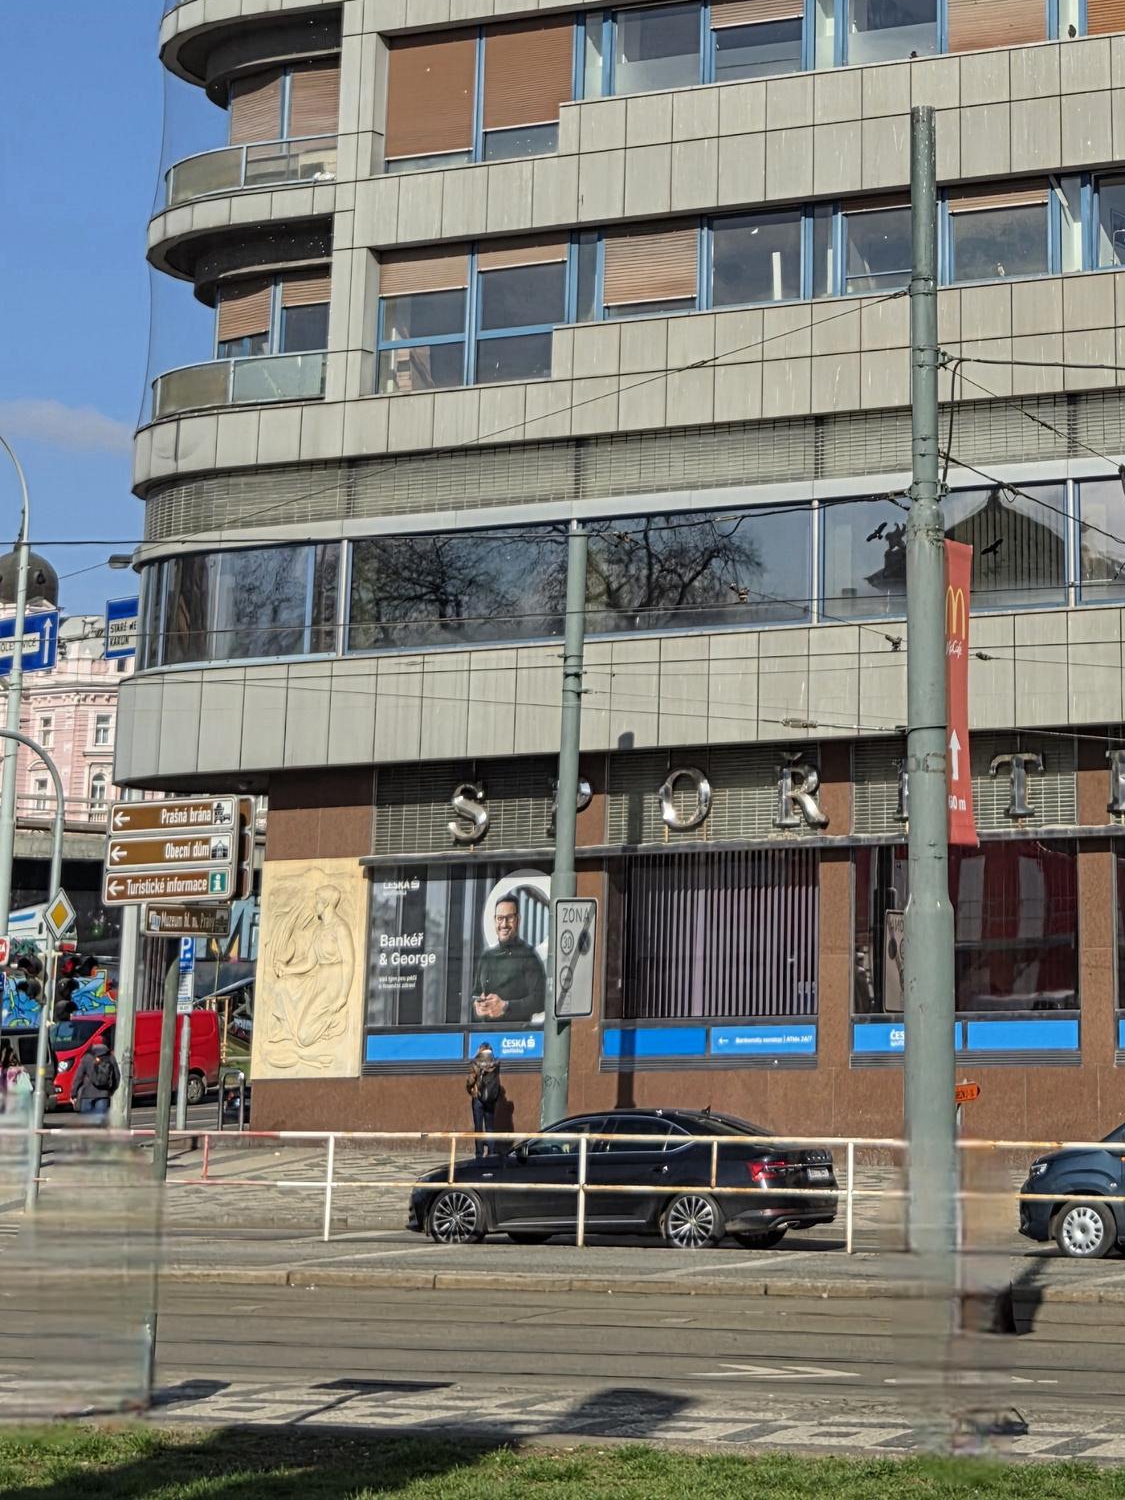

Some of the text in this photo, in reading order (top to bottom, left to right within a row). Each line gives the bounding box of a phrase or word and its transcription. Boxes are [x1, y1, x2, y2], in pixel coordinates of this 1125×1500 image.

[161, 806, 212, 825] Prašná brána
[165, 840, 210, 859] Obecní dům
[127, 876, 208, 896] Turistické informace
[161, 911, 183, 928] Muzeum
[380, 932, 424, 947] Bankéř
[562, 936, 572, 949] 30
[380, 952, 436, 968] & George
[890, 1029, 904, 1040] ČES
[502, 1038, 526, 1048] ČESKÁ
